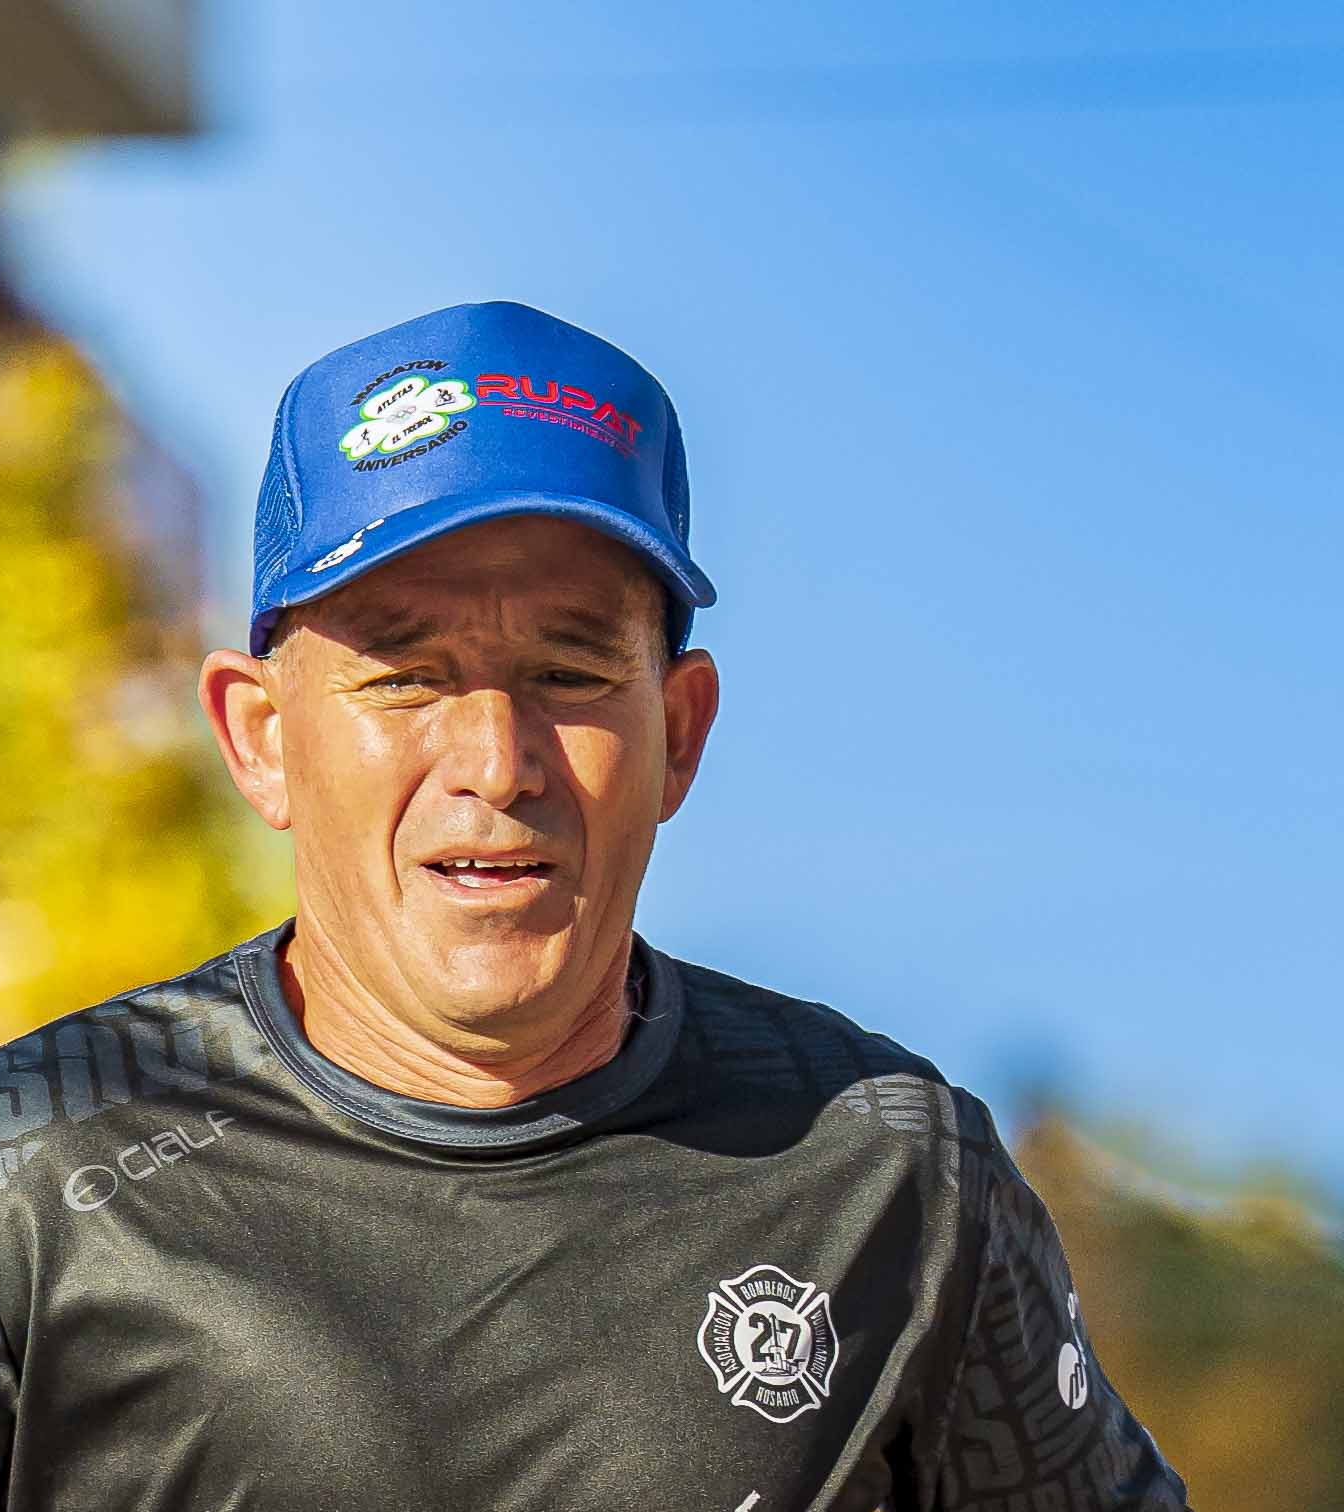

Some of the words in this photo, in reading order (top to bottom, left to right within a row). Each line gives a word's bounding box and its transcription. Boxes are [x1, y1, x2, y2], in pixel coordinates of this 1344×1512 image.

[377, 383, 414, 415] ATLETAS
[352, 420, 468, 473] ANIVERSARIO
[739, 1280, 797, 1303] BOMBEROS
[748, 1312, 802, 1364] 27
[755, 1386, 800, 1407] ROSARIO
